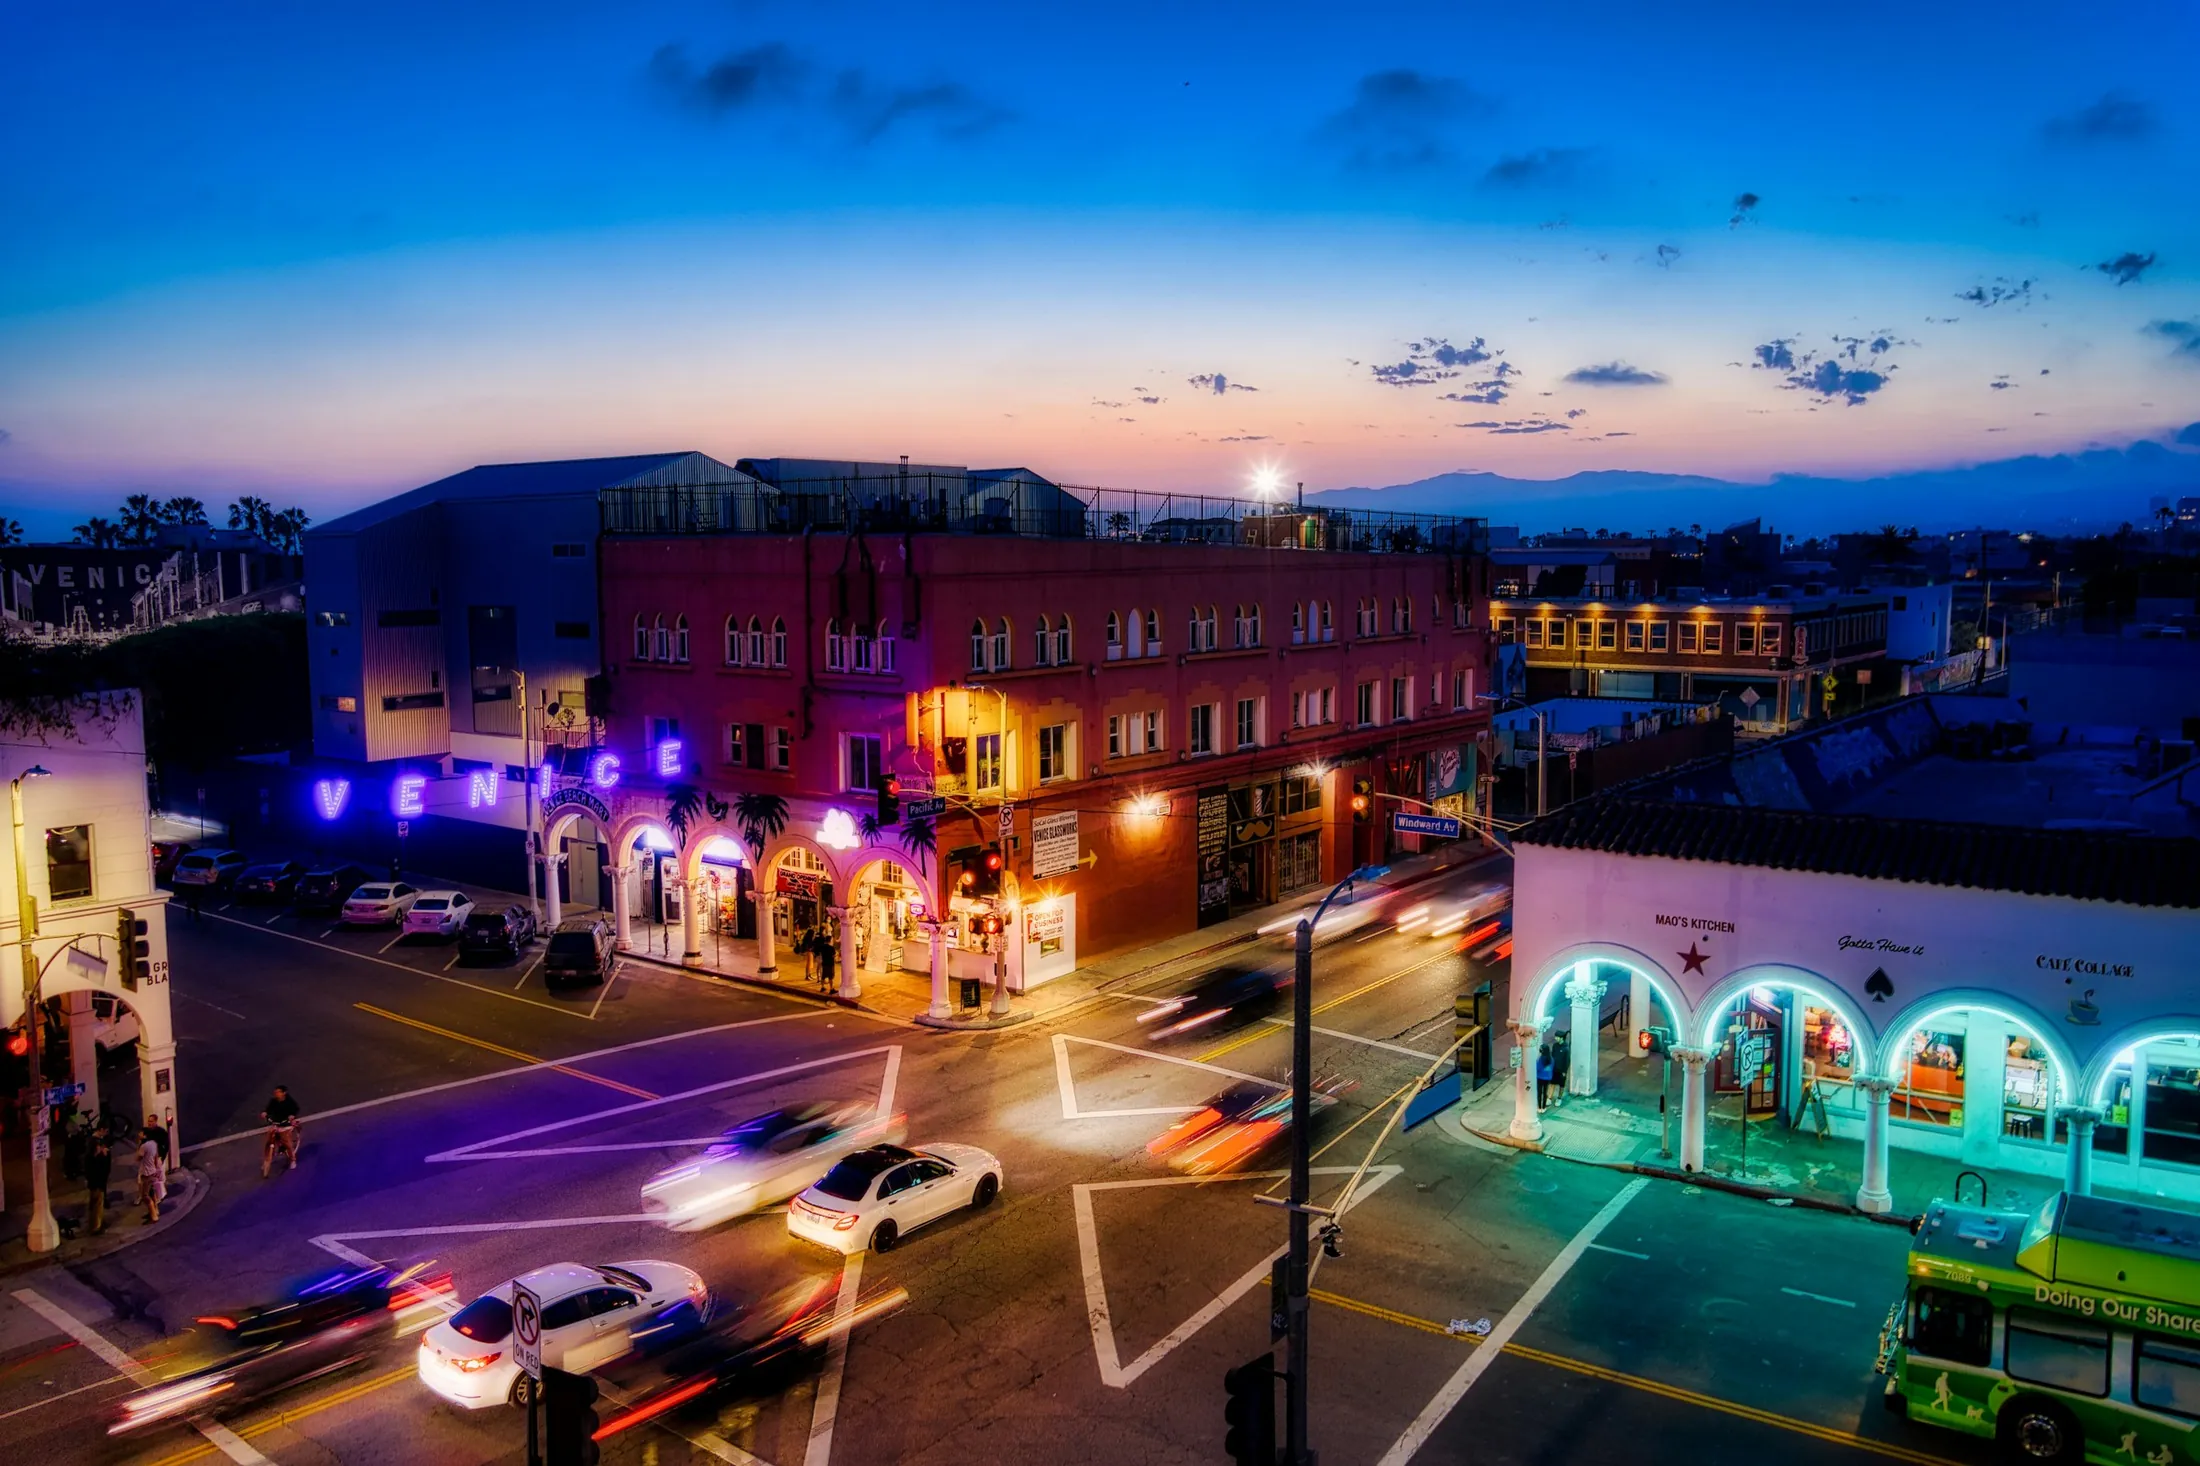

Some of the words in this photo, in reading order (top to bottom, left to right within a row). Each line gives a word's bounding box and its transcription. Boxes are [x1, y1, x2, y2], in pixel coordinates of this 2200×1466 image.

[28, 562, 178, 589] VENICE
[318, 740, 681, 819] VENICE
[564, 789, 588, 807] BEACH
[588, 794, 609, 820] MART
[910, 802, 934, 814] Pacific
[935, 801, 944, 810] Av
[1398, 816, 1441, 831] Windward
[1443, 821, 1456, 832] Av
[1655, 914, 1689, 928] MAO'S
[1691, 918, 1735, 933] KITCHEN
[1837, 935, 1875, 951] Gotta
[1876, 938, 1911, 954] Have
[1911, 944, 1925, 956] it
[2074, 959, 2134, 978] COLLAGE
[1945, 1271, 1972, 1284] 7089
[2034, 1284, 2095, 1316] Doing
[2102, 1298, 2141, 1321] Our
[2146, 1306, 2200, 1334] Share
[515, 1343, 525, 1360] ON
[526, 1350, 539, 1370] RED
